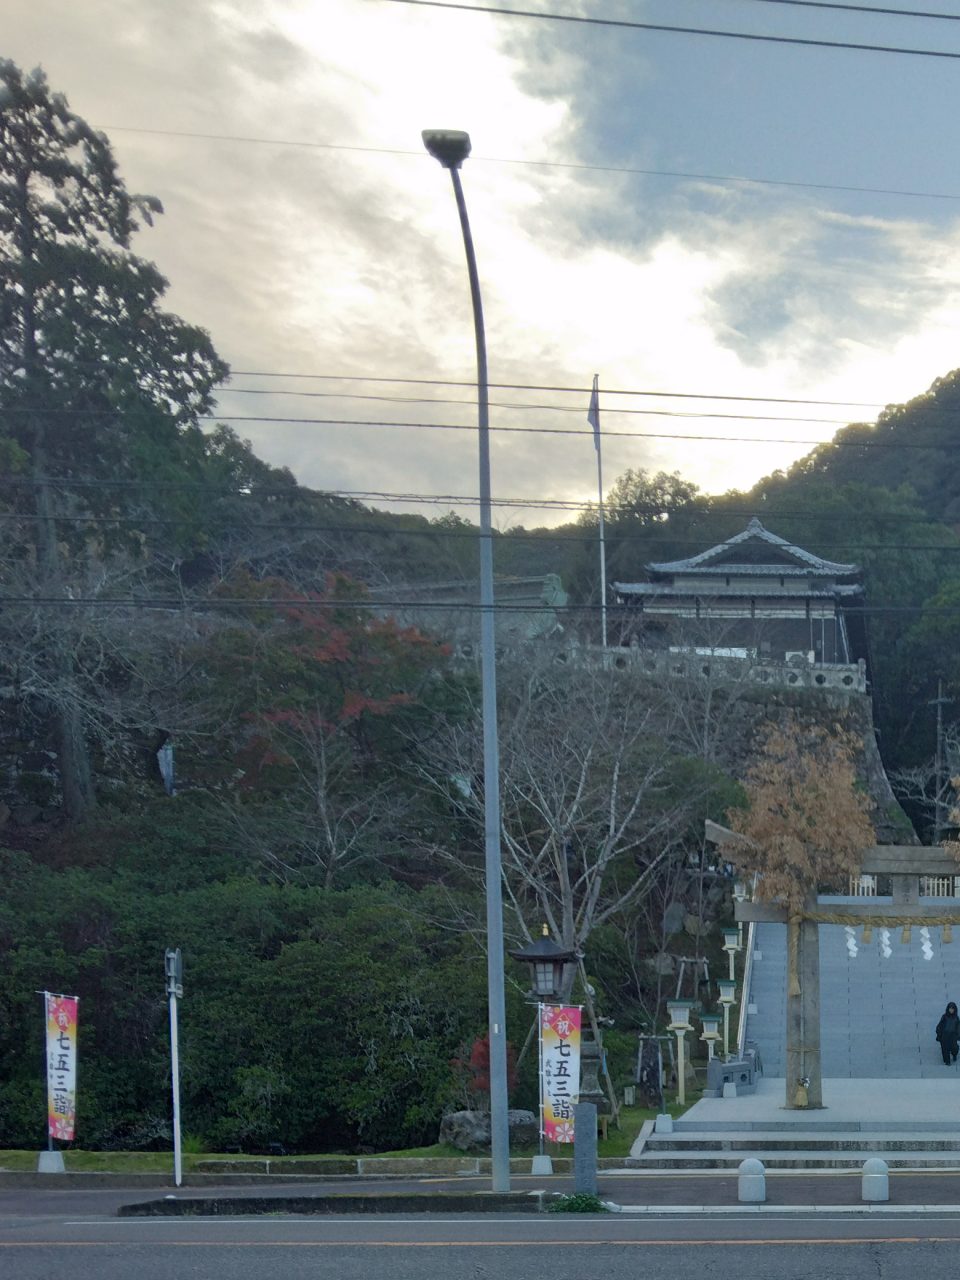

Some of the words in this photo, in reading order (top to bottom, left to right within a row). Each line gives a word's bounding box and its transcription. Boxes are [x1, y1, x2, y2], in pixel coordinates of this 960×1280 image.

[557, 1017, 570, 1036] 祝
[54, 1031, 71, 1115] 七五三詣
[552, 1039, 571, 1121] 七五三詣
